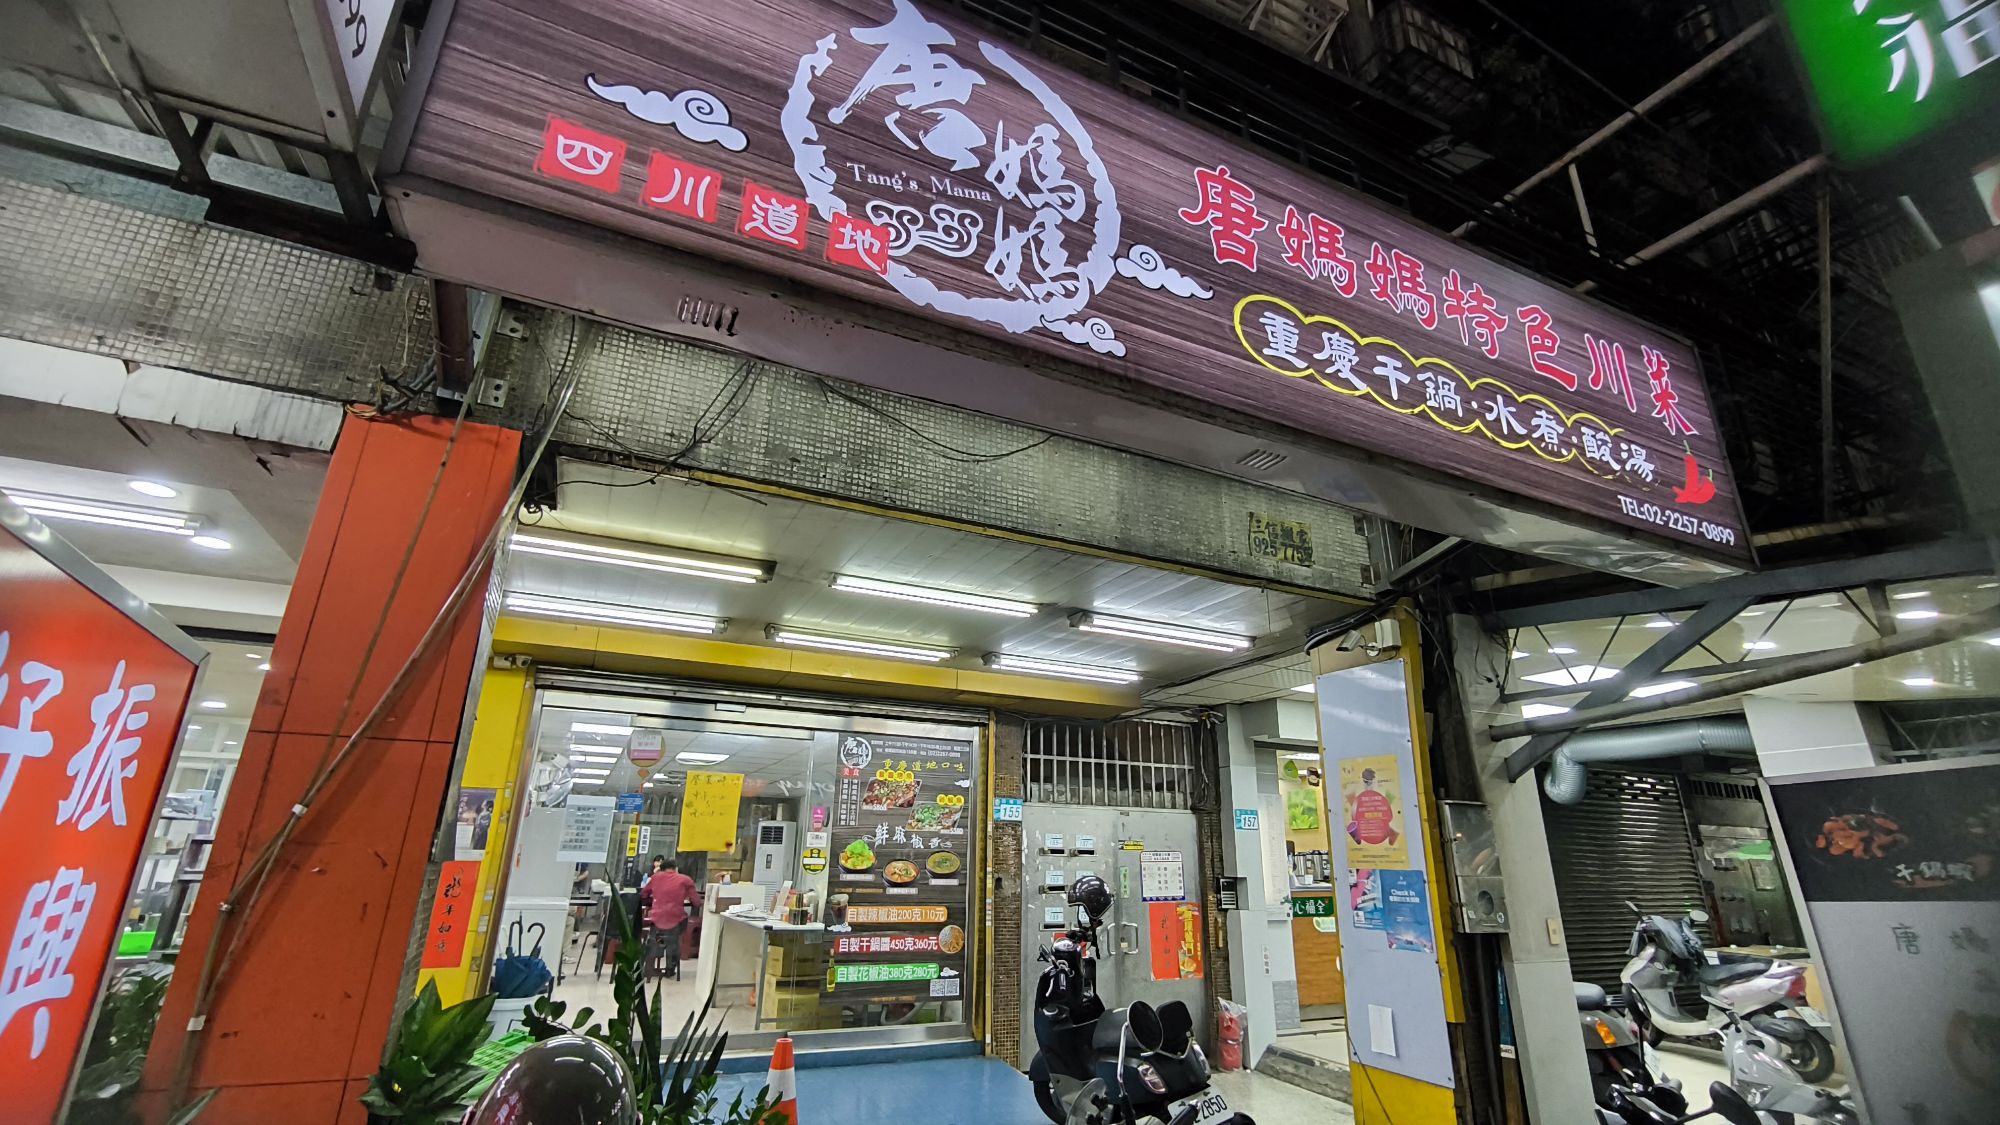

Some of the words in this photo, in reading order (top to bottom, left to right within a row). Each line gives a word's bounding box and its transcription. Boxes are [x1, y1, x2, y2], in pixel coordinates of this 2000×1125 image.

[339, 0, 367, 59] 99
[846, 162, 919, 193] Tang's
[930, 175, 992, 202] Mama
[556, 134, 882, 271] 四川道地
[1179, 165, 1699, 437] 唐媽媽特色川菜
[1003, 806, 1020, 819] 155
[1242, 816, 1257, 828] 157
[1291, 899, 1326, 915] 心福全
